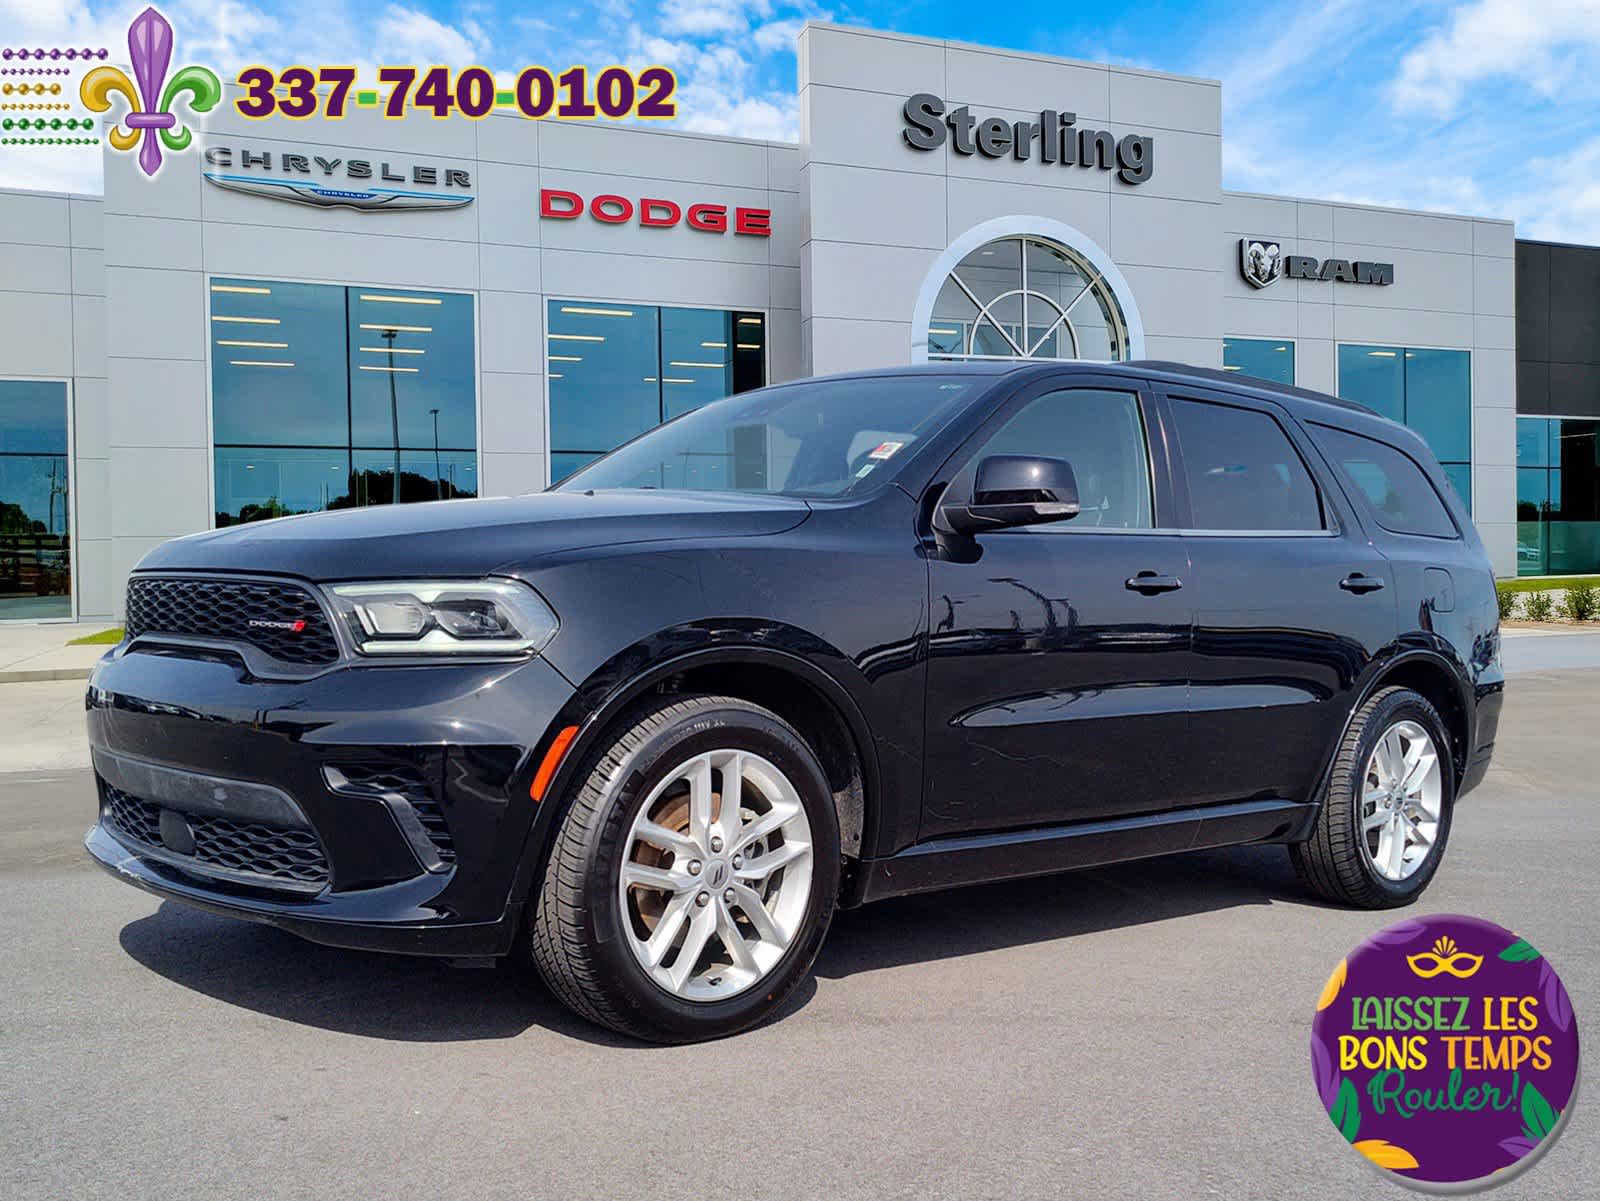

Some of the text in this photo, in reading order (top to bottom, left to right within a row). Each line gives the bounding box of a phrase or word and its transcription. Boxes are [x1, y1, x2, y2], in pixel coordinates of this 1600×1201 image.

[903, 93, 1153, 184] Sterling
[205, 147, 471, 187] CHRYSLER
[540, 189, 772, 236] DODGE
[1285, 255, 1394, 286] RAM
[249, 620, 293, 629] DODGE
